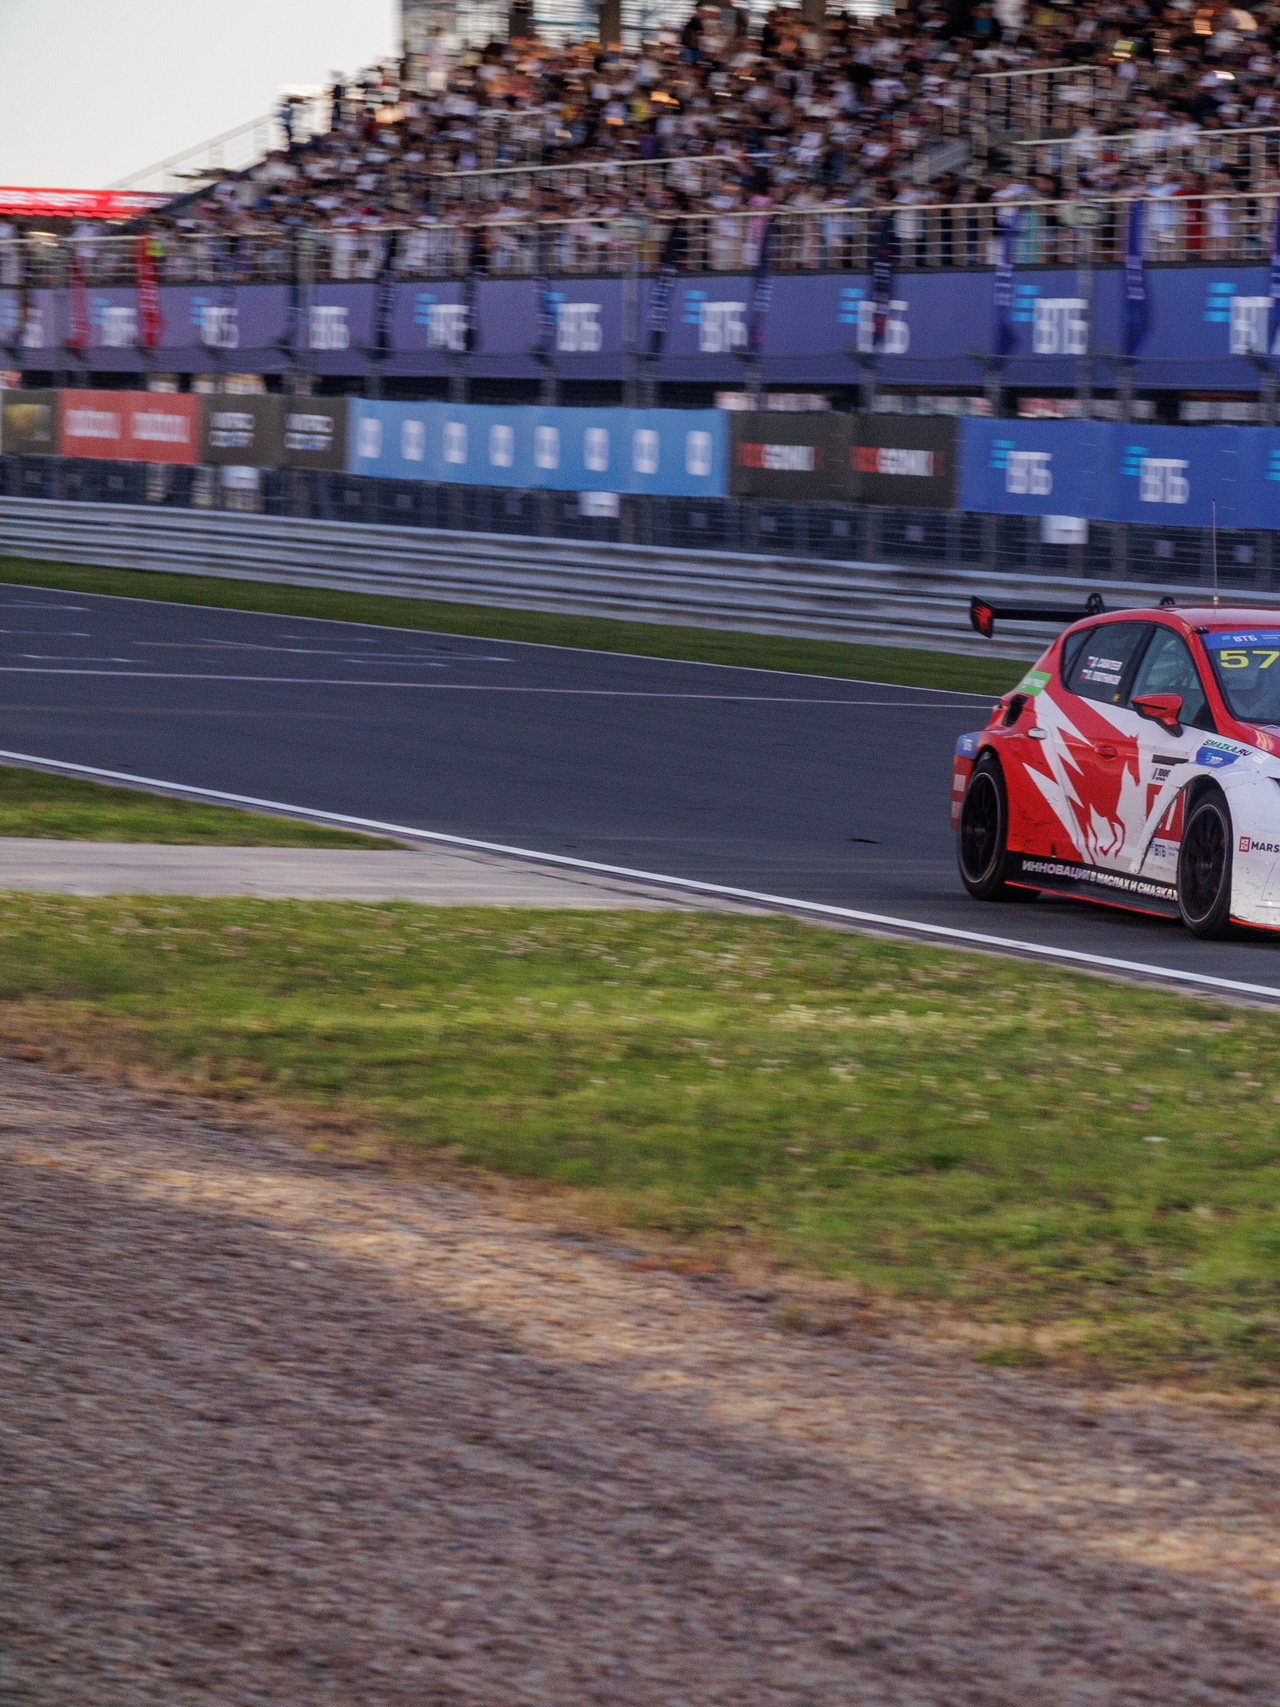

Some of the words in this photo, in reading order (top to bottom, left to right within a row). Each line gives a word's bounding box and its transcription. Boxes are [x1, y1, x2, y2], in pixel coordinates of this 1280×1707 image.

[1232, 634, 1258, 643] ВТБ
[1219, 650, 1280, 669] 57
[1203, 739, 1252, 757] SMAZKA.RU
[1022, 860, 1091, 881] ИННОВАЦИИ
[1096, 873, 1130, 891] МАСЛАХ
[1129, 881, 1138, 892] И
[1137, 882, 1179, 902] СМАЗКАХ
